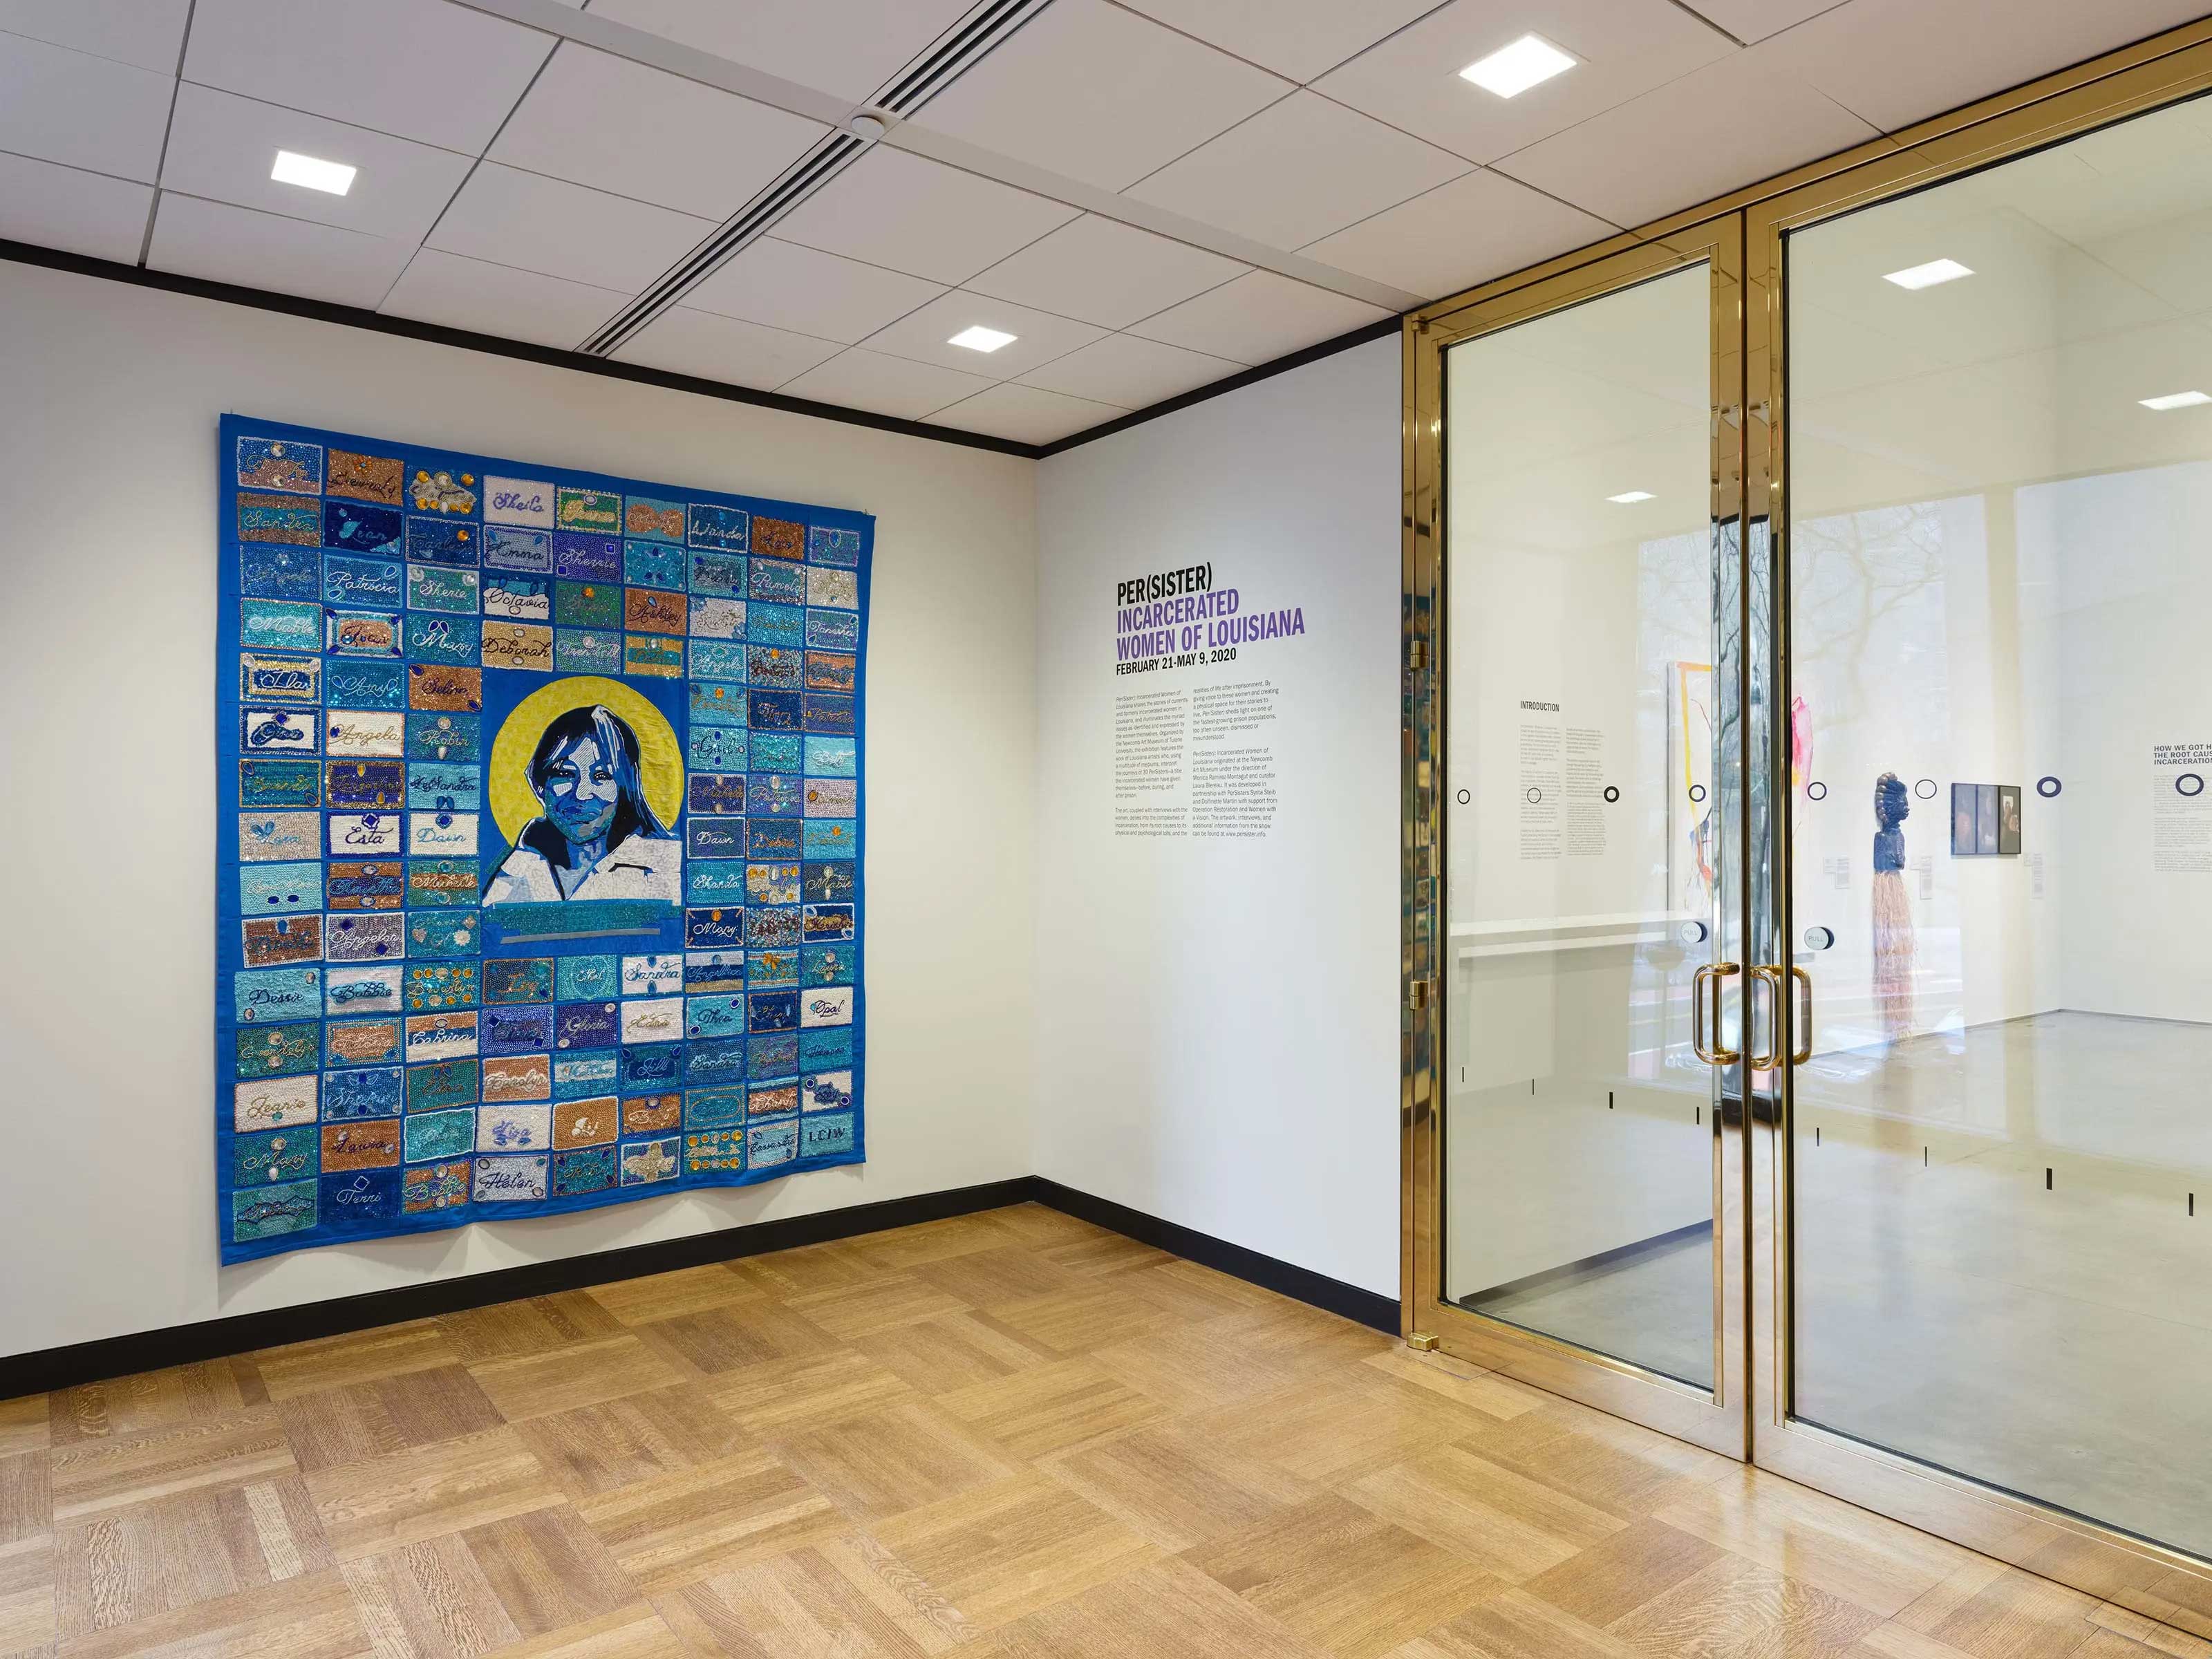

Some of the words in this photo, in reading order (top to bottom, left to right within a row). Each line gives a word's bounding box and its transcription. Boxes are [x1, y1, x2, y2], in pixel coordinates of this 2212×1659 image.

[327, 571, 399, 594] Patricia
[1117, 562, 1212, 606] PER(SISTER)
[1117, 588, 1239, 634] INCARCERATED
[1116, 628, 1175, 661] WOMEN
[1182, 626, 1203, 651] OF
[1208, 608, 1305, 648] LOUISIANA
[481, 637, 552, 657] Deborah
[1116, 659, 1159, 675] FEBRUARY
[1162, 653, 1196, 669] 21-MAY
[1199, 651, 1208, 666] 9,
[1211, 648, 1237, 664] 2020
[1520, 700, 1559, 712] INTRODUCTION
[329, 724, 400, 745] Angela
[346, 826, 394, 844] Esta
[697, 830, 735, 845] Dawn
[625, 962, 682, 981] Sandra
